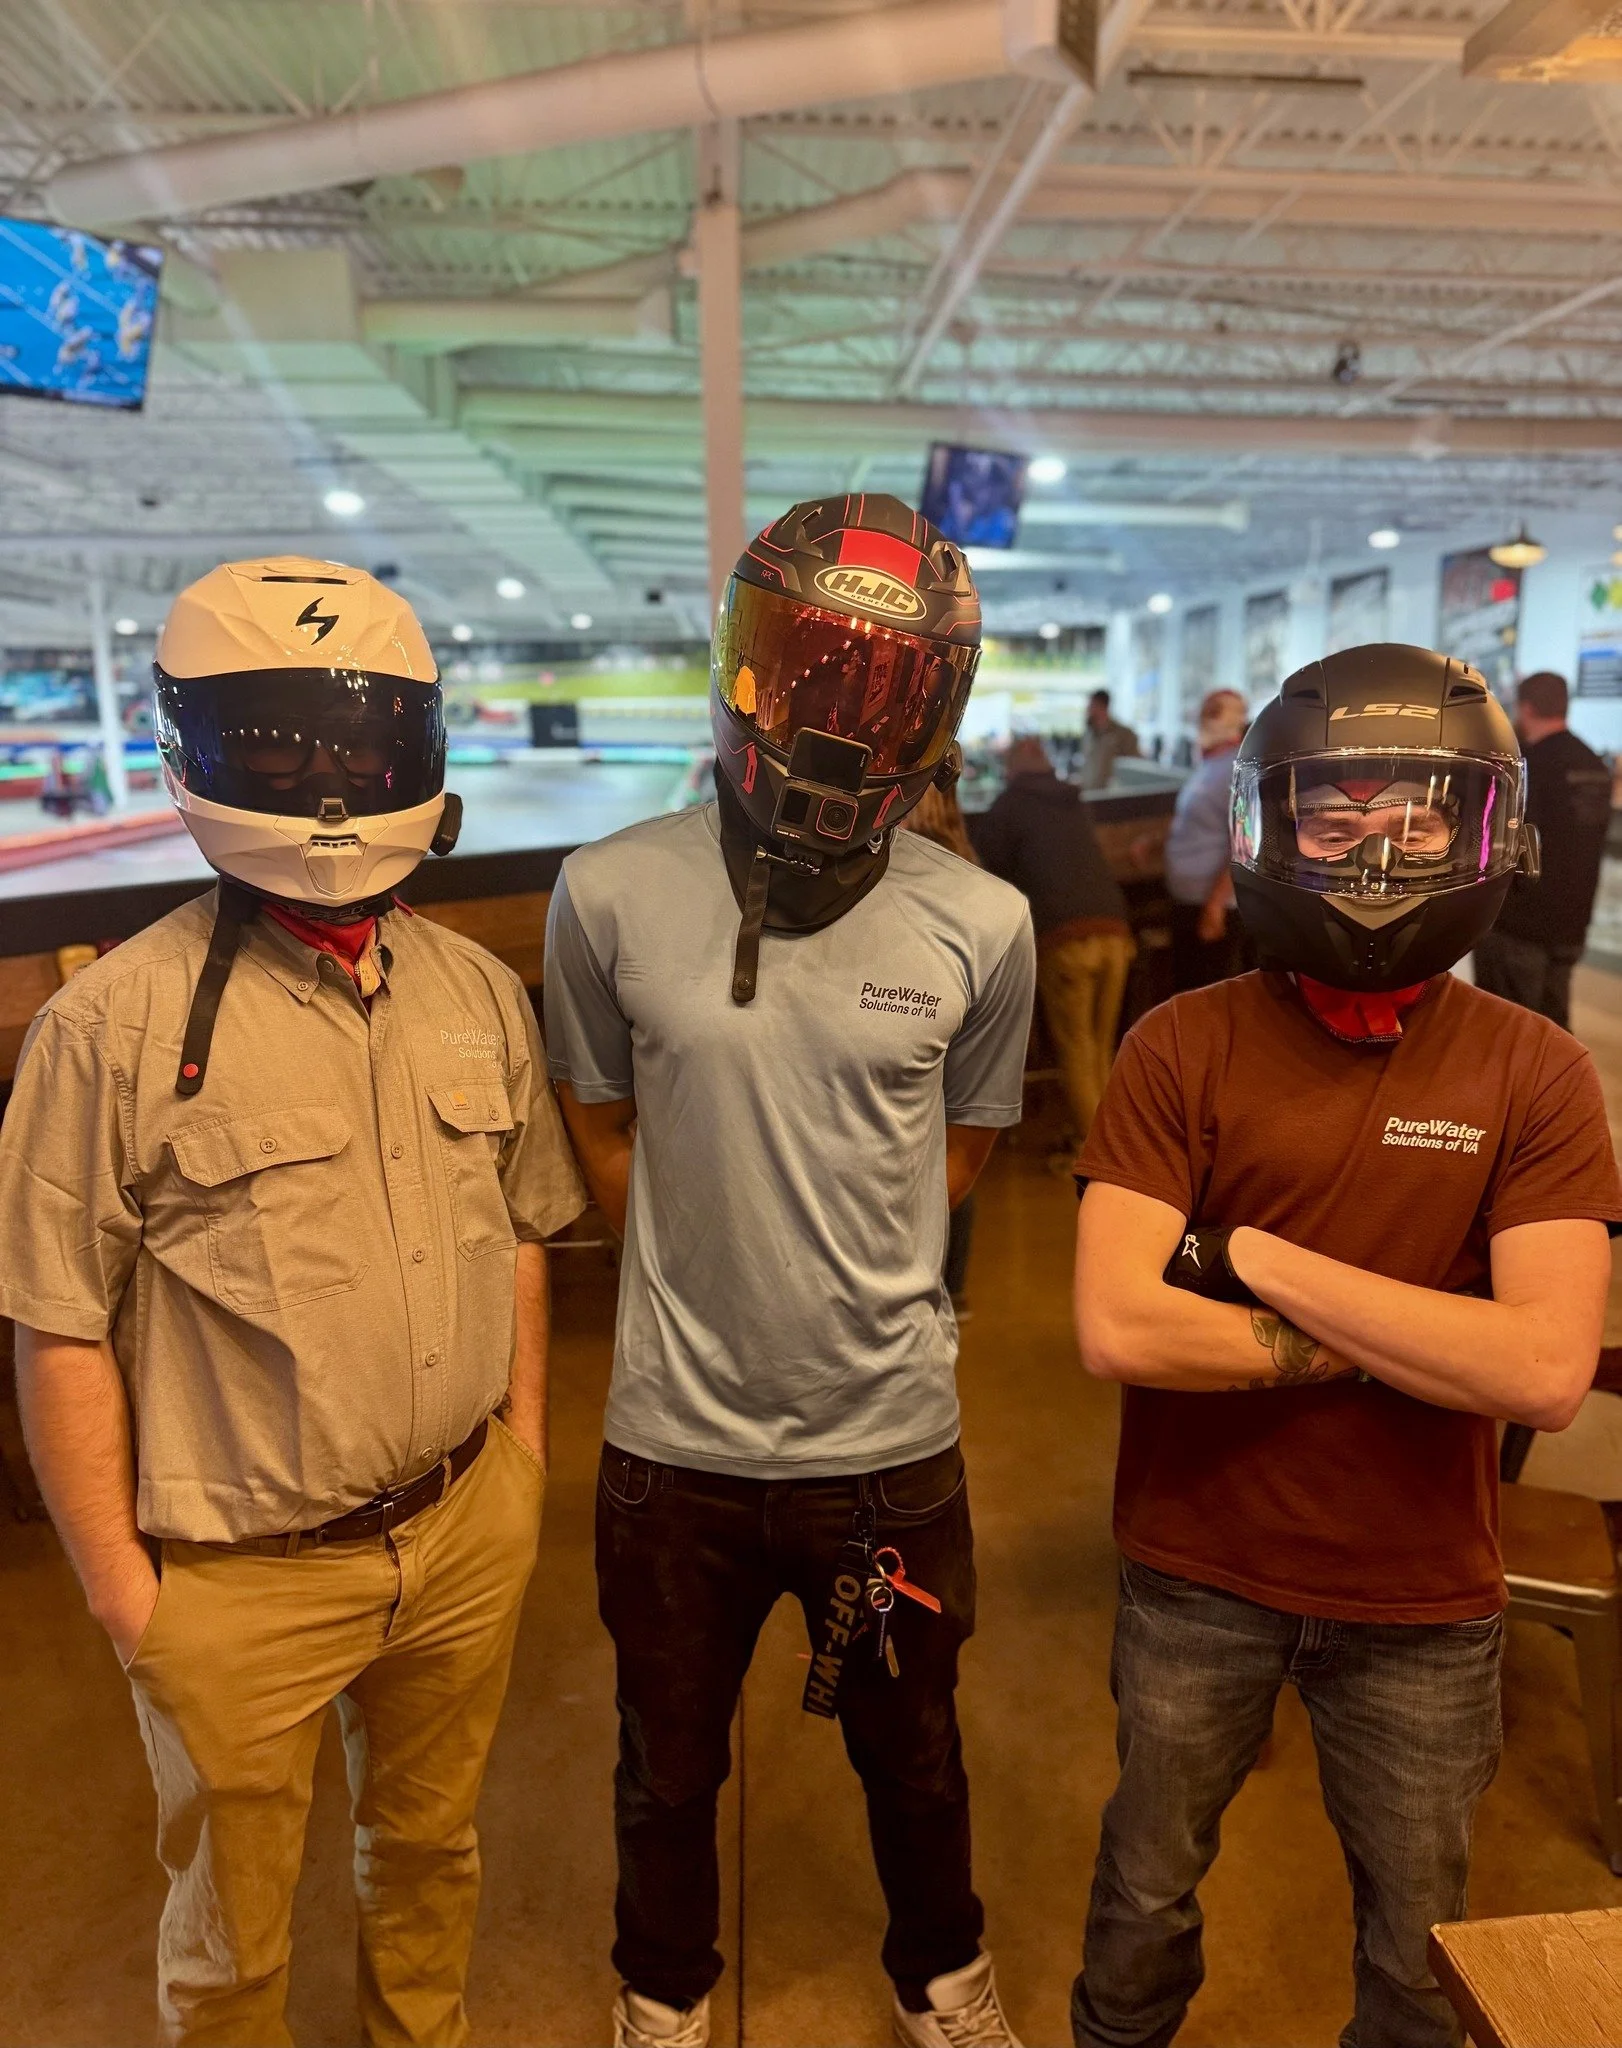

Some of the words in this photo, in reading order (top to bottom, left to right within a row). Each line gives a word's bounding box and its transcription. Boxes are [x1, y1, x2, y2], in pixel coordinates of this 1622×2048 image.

[829, 572, 915, 611] HJC
[1329, 703, 1440, 721] LS2
[860, 982, 942, 1007] PureWater
[859, 998, 909, 1015] Solutions
[911, 1005, 924, 1017] of
[924, 1007, 938, 1020] VA
[440, 1029, 500, 1046] PureWater
[1384, 1116, 1486, 1141] PureWater
[1382, 1132, 1442, 1150] Solutions
[1444, 1139, 1462, 1152] of
[1462, 1140, 1479, 1155] VA
